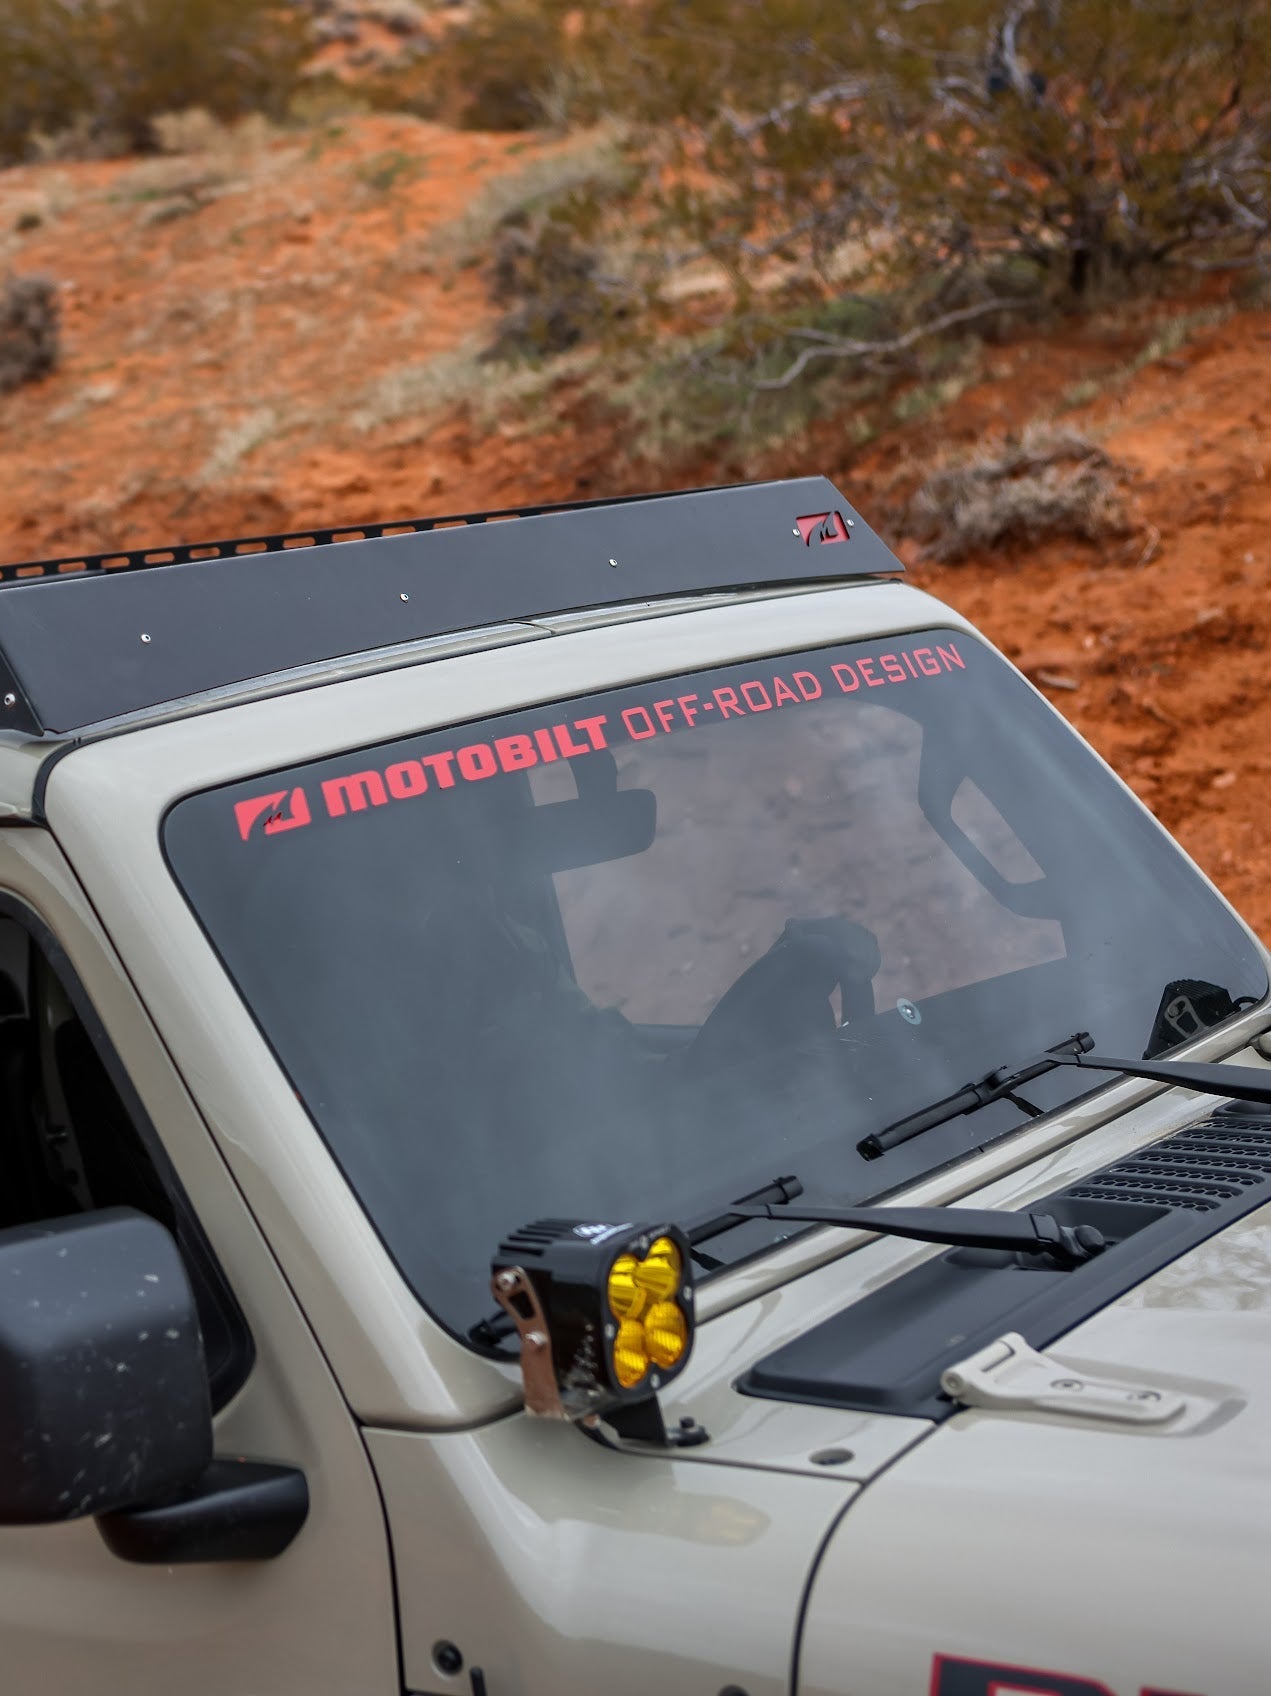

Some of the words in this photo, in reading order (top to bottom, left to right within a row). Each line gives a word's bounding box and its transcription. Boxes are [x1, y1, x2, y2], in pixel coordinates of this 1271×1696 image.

[321, 715, 608, 817] MOTOBILT
[622, 671, 822, 740] OFF-ROAD
[832, 643, 966, 692] DESIGN
